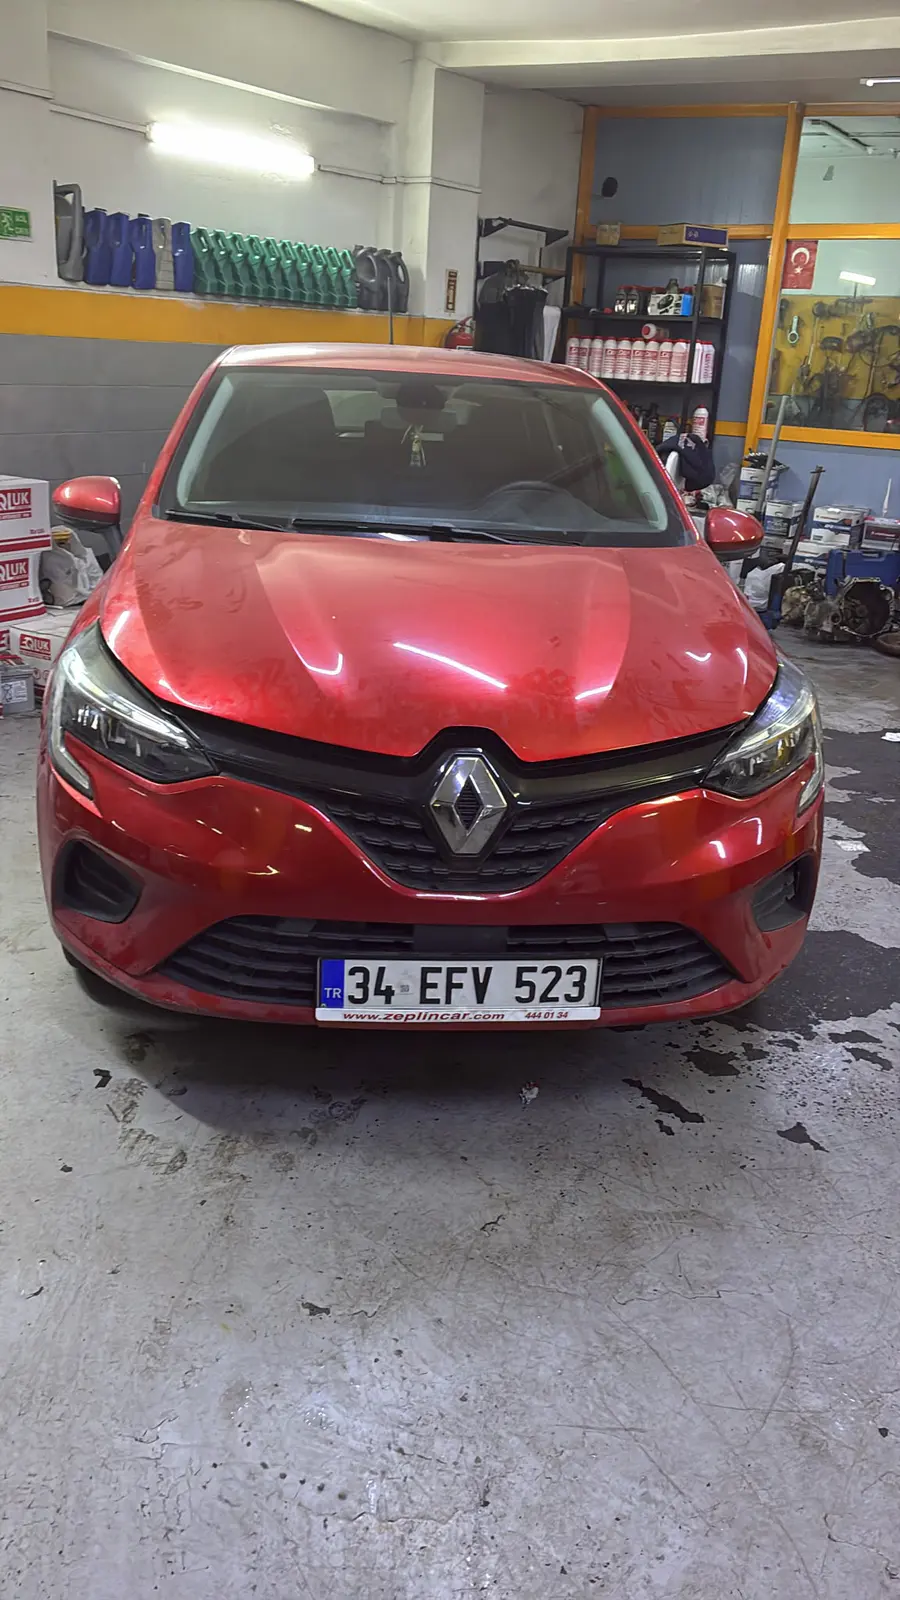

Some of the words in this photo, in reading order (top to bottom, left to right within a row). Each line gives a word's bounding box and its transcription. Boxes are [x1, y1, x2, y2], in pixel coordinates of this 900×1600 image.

[347, 966, 395, 1005] 34
[419, 966, 493, 1005] EFV
[514, 965, 587, 1004] 523
[324, 987, 342, 999] TR
[343, 1010, 505, 1022] www.zeplincar.com
[525, 1011, 541, 1019] 444
[544, 1011, 555, 1019] 01
[557, 1011, 569, 1019] 34
